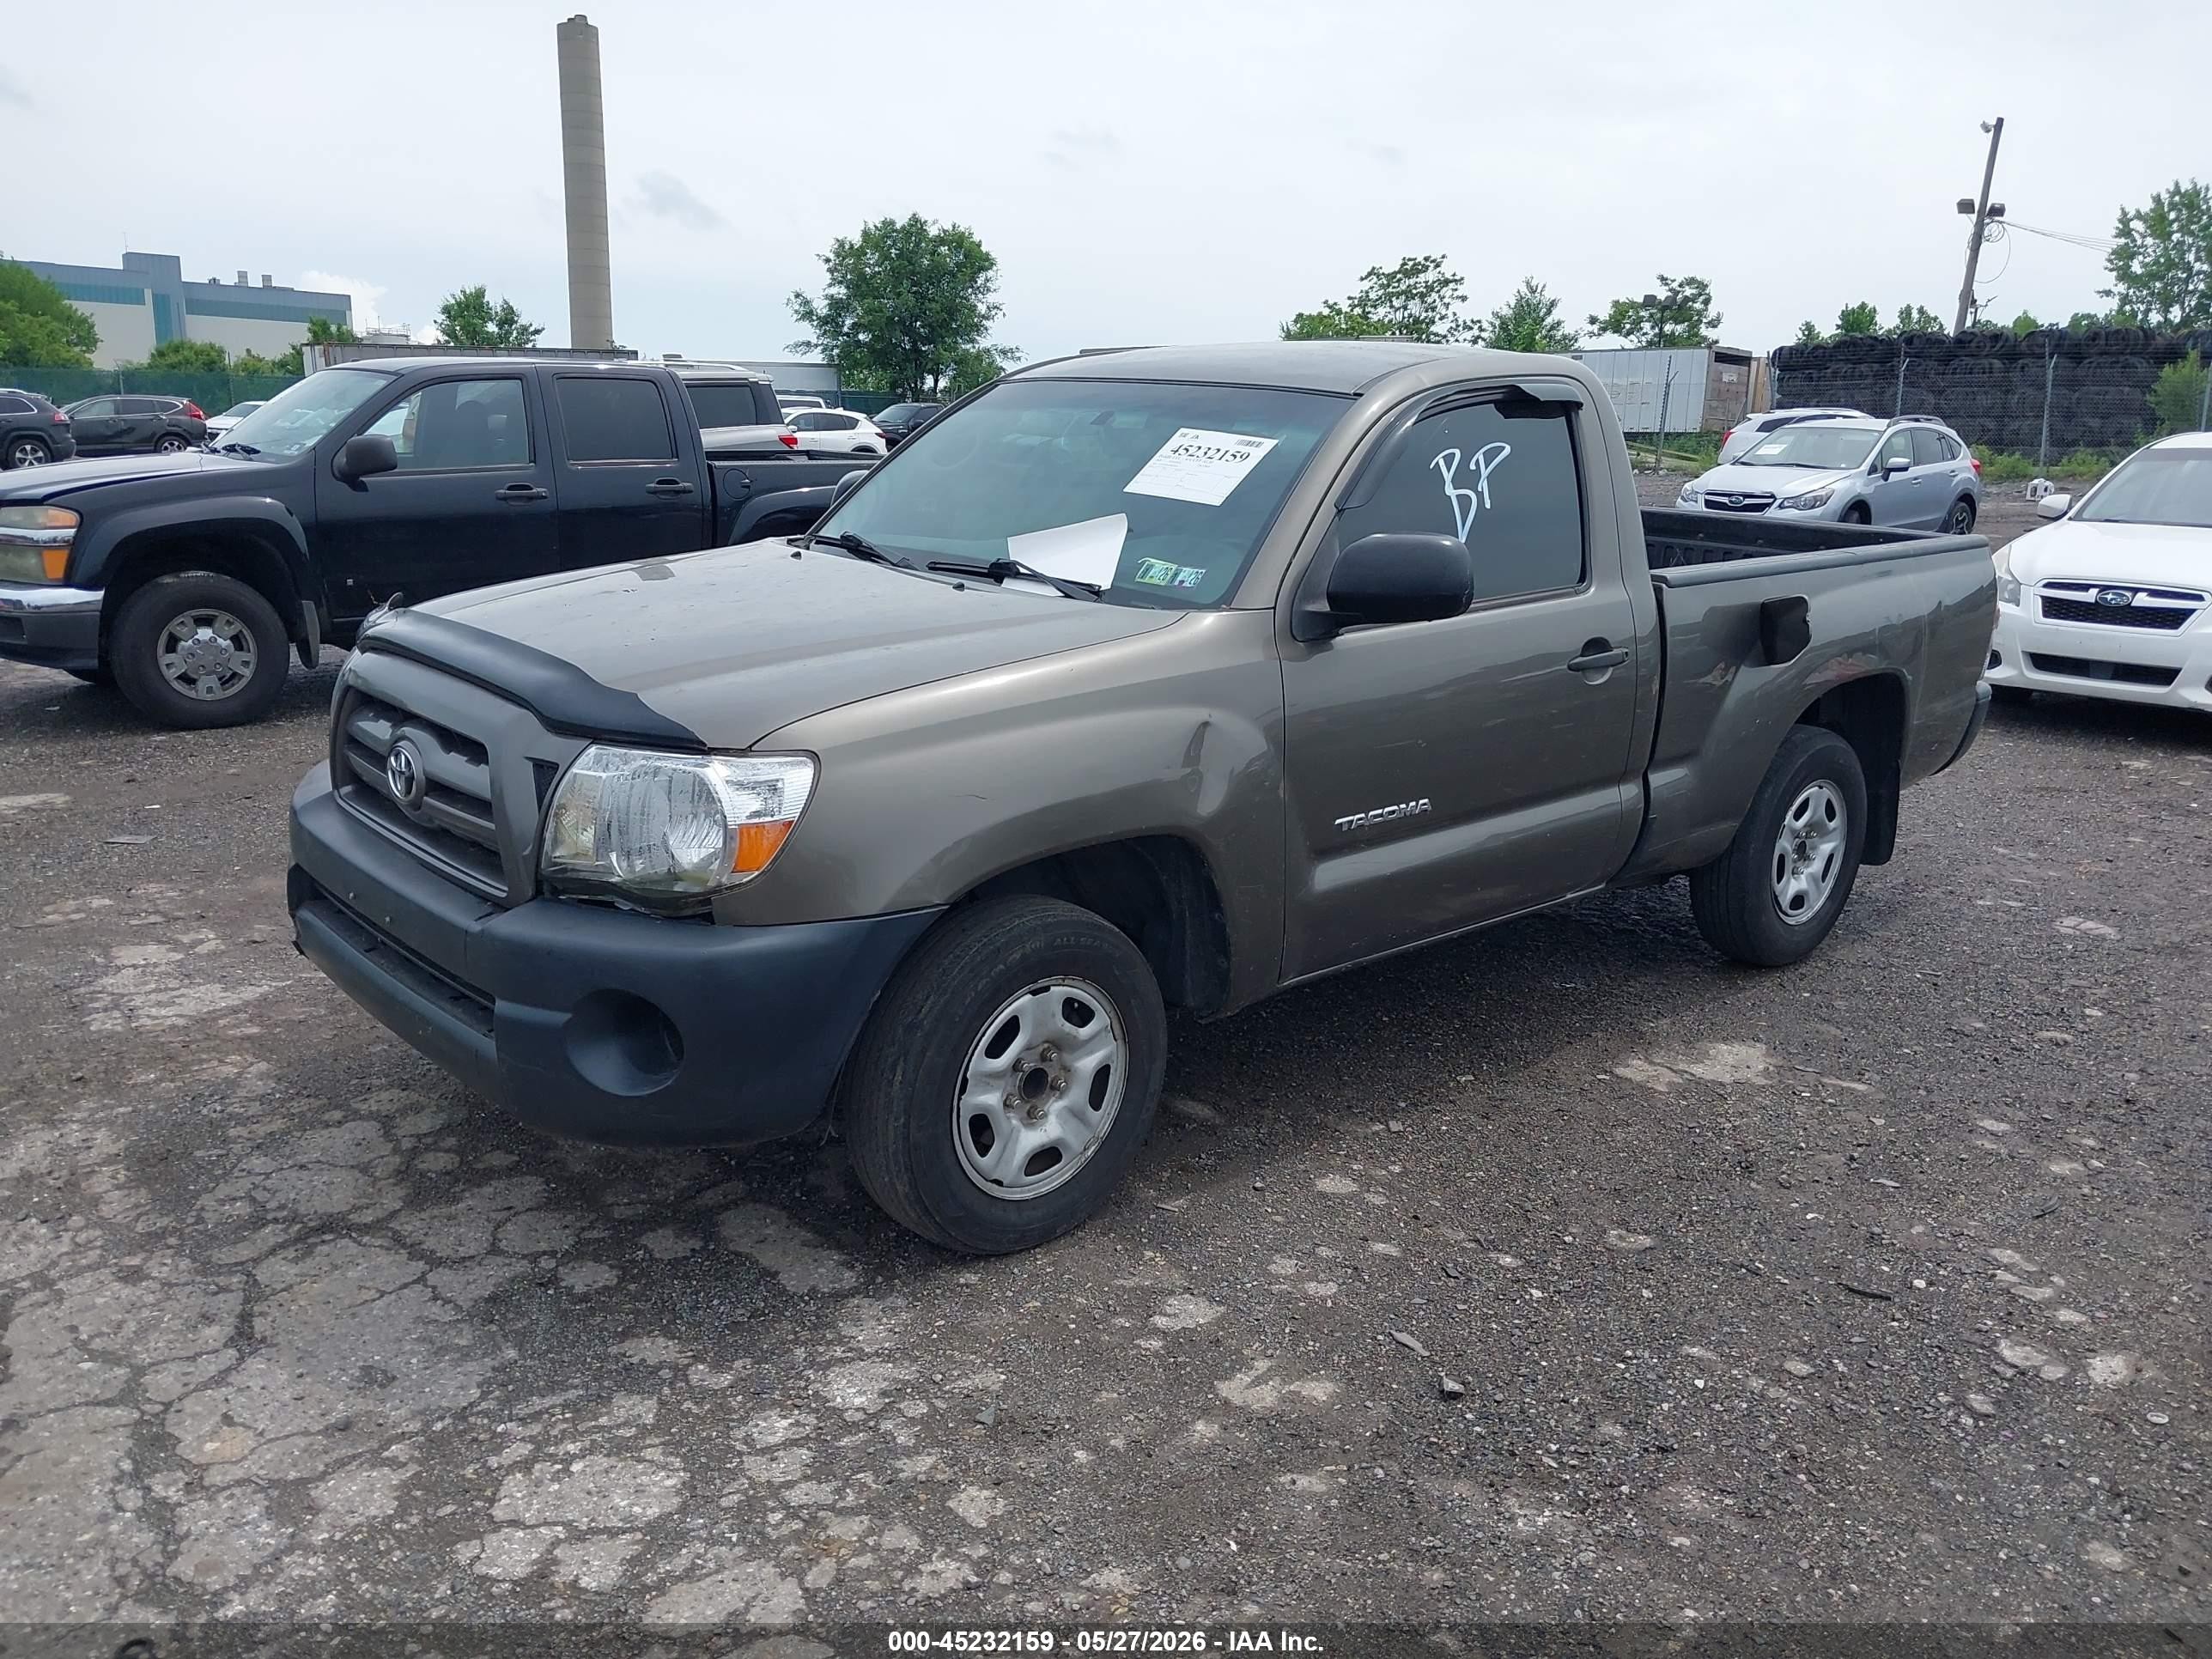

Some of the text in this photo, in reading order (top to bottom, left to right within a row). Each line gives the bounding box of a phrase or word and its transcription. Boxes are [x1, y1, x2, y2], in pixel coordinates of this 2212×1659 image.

[1170, 444, 1251, 464] 45232159
[1430, 442, 1511, 543] BP
[1334, 799, 1432, 831] TACOMA
